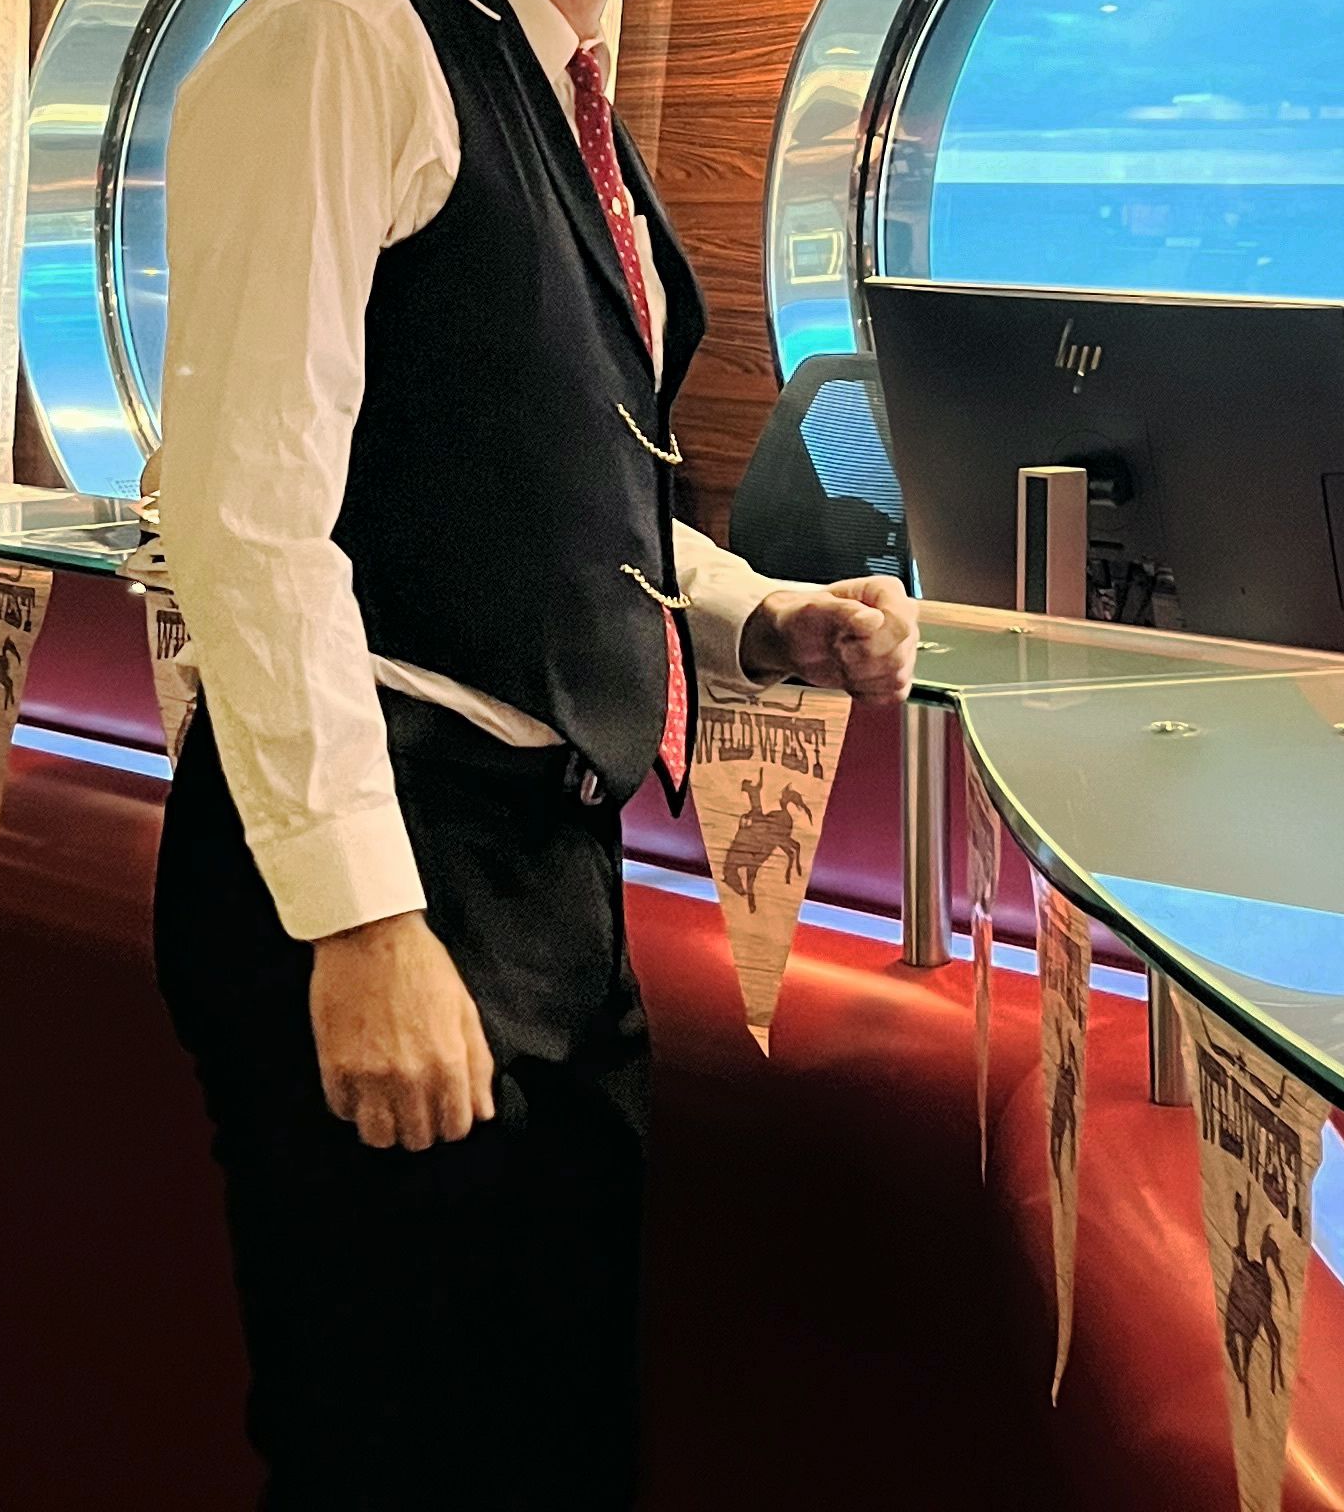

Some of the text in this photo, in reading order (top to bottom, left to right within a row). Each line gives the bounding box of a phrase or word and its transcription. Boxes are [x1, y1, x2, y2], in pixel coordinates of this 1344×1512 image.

[1056, 318, 1102, 393] hp
[696, 706, 826, 780] WILD WEST
